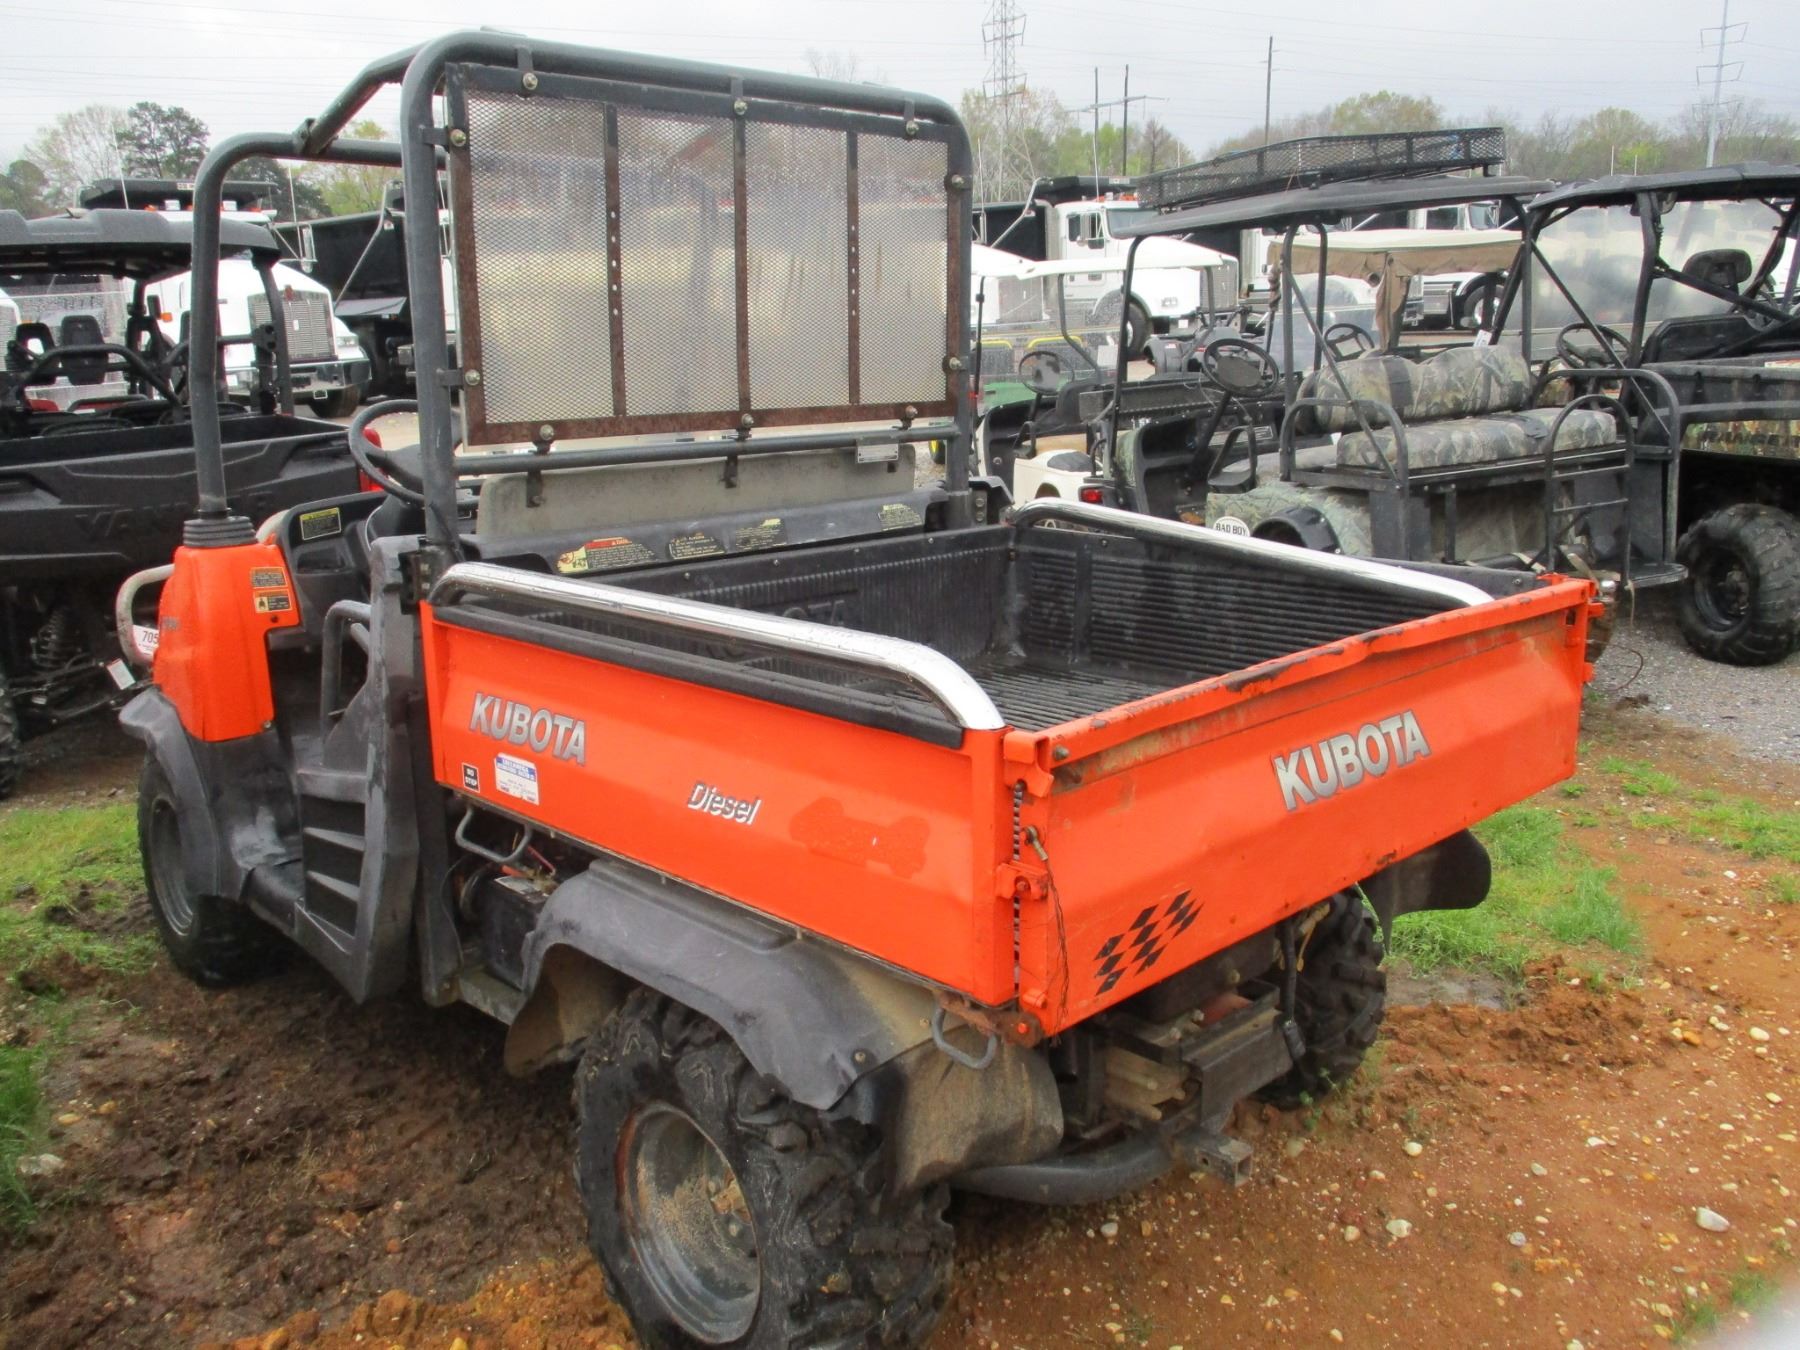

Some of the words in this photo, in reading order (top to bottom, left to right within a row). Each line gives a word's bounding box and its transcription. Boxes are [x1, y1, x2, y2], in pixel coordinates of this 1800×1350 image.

[1216, 523, 1231, 533] BAD
[1232, 525, 1246, 536] BOY
[469, 693, 586, 766] KUBOTA
[1274, 709, 1432, 811] KUBOTA
[688, 781, 762, 825] Diesel
